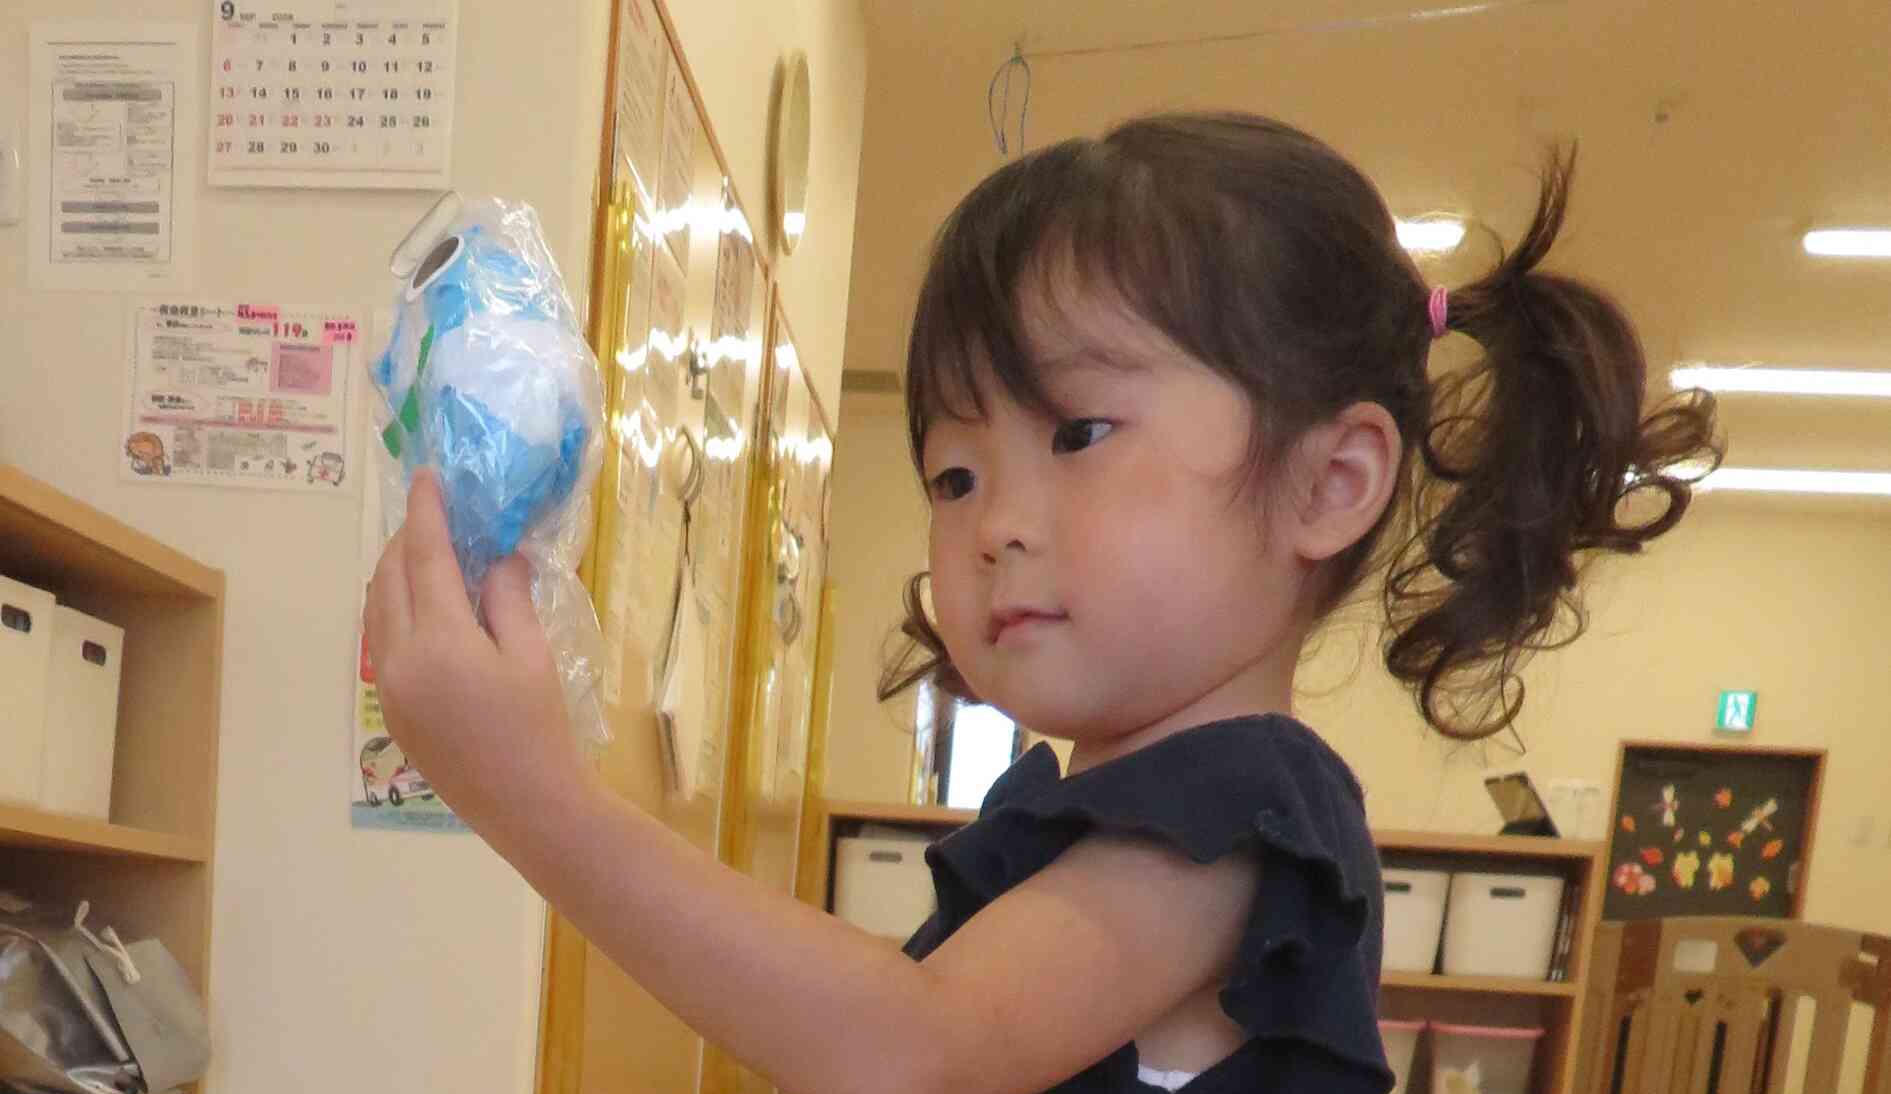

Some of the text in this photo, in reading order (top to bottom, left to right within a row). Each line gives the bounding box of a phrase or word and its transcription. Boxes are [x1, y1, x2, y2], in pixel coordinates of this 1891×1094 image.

[220, 0, 235, 21] 9
[290, 32, 430, 47] 1 2 3 4 5
[223, 59, 232, 73] 6
[256, 59, 264, 72] 7
[288, 60, 297, 73] 8
[352, 60, 367, 74] 10
[384, 60, 398, 73] 11
[417, 60, 432, 73] 12
[220, 86, 432, 101] 13 14 15 16 17 18 19
[216, 113, 430, 129] 20 21 22 23 24 25 26
[216, 140, 330, 154] 27 28 29 30
